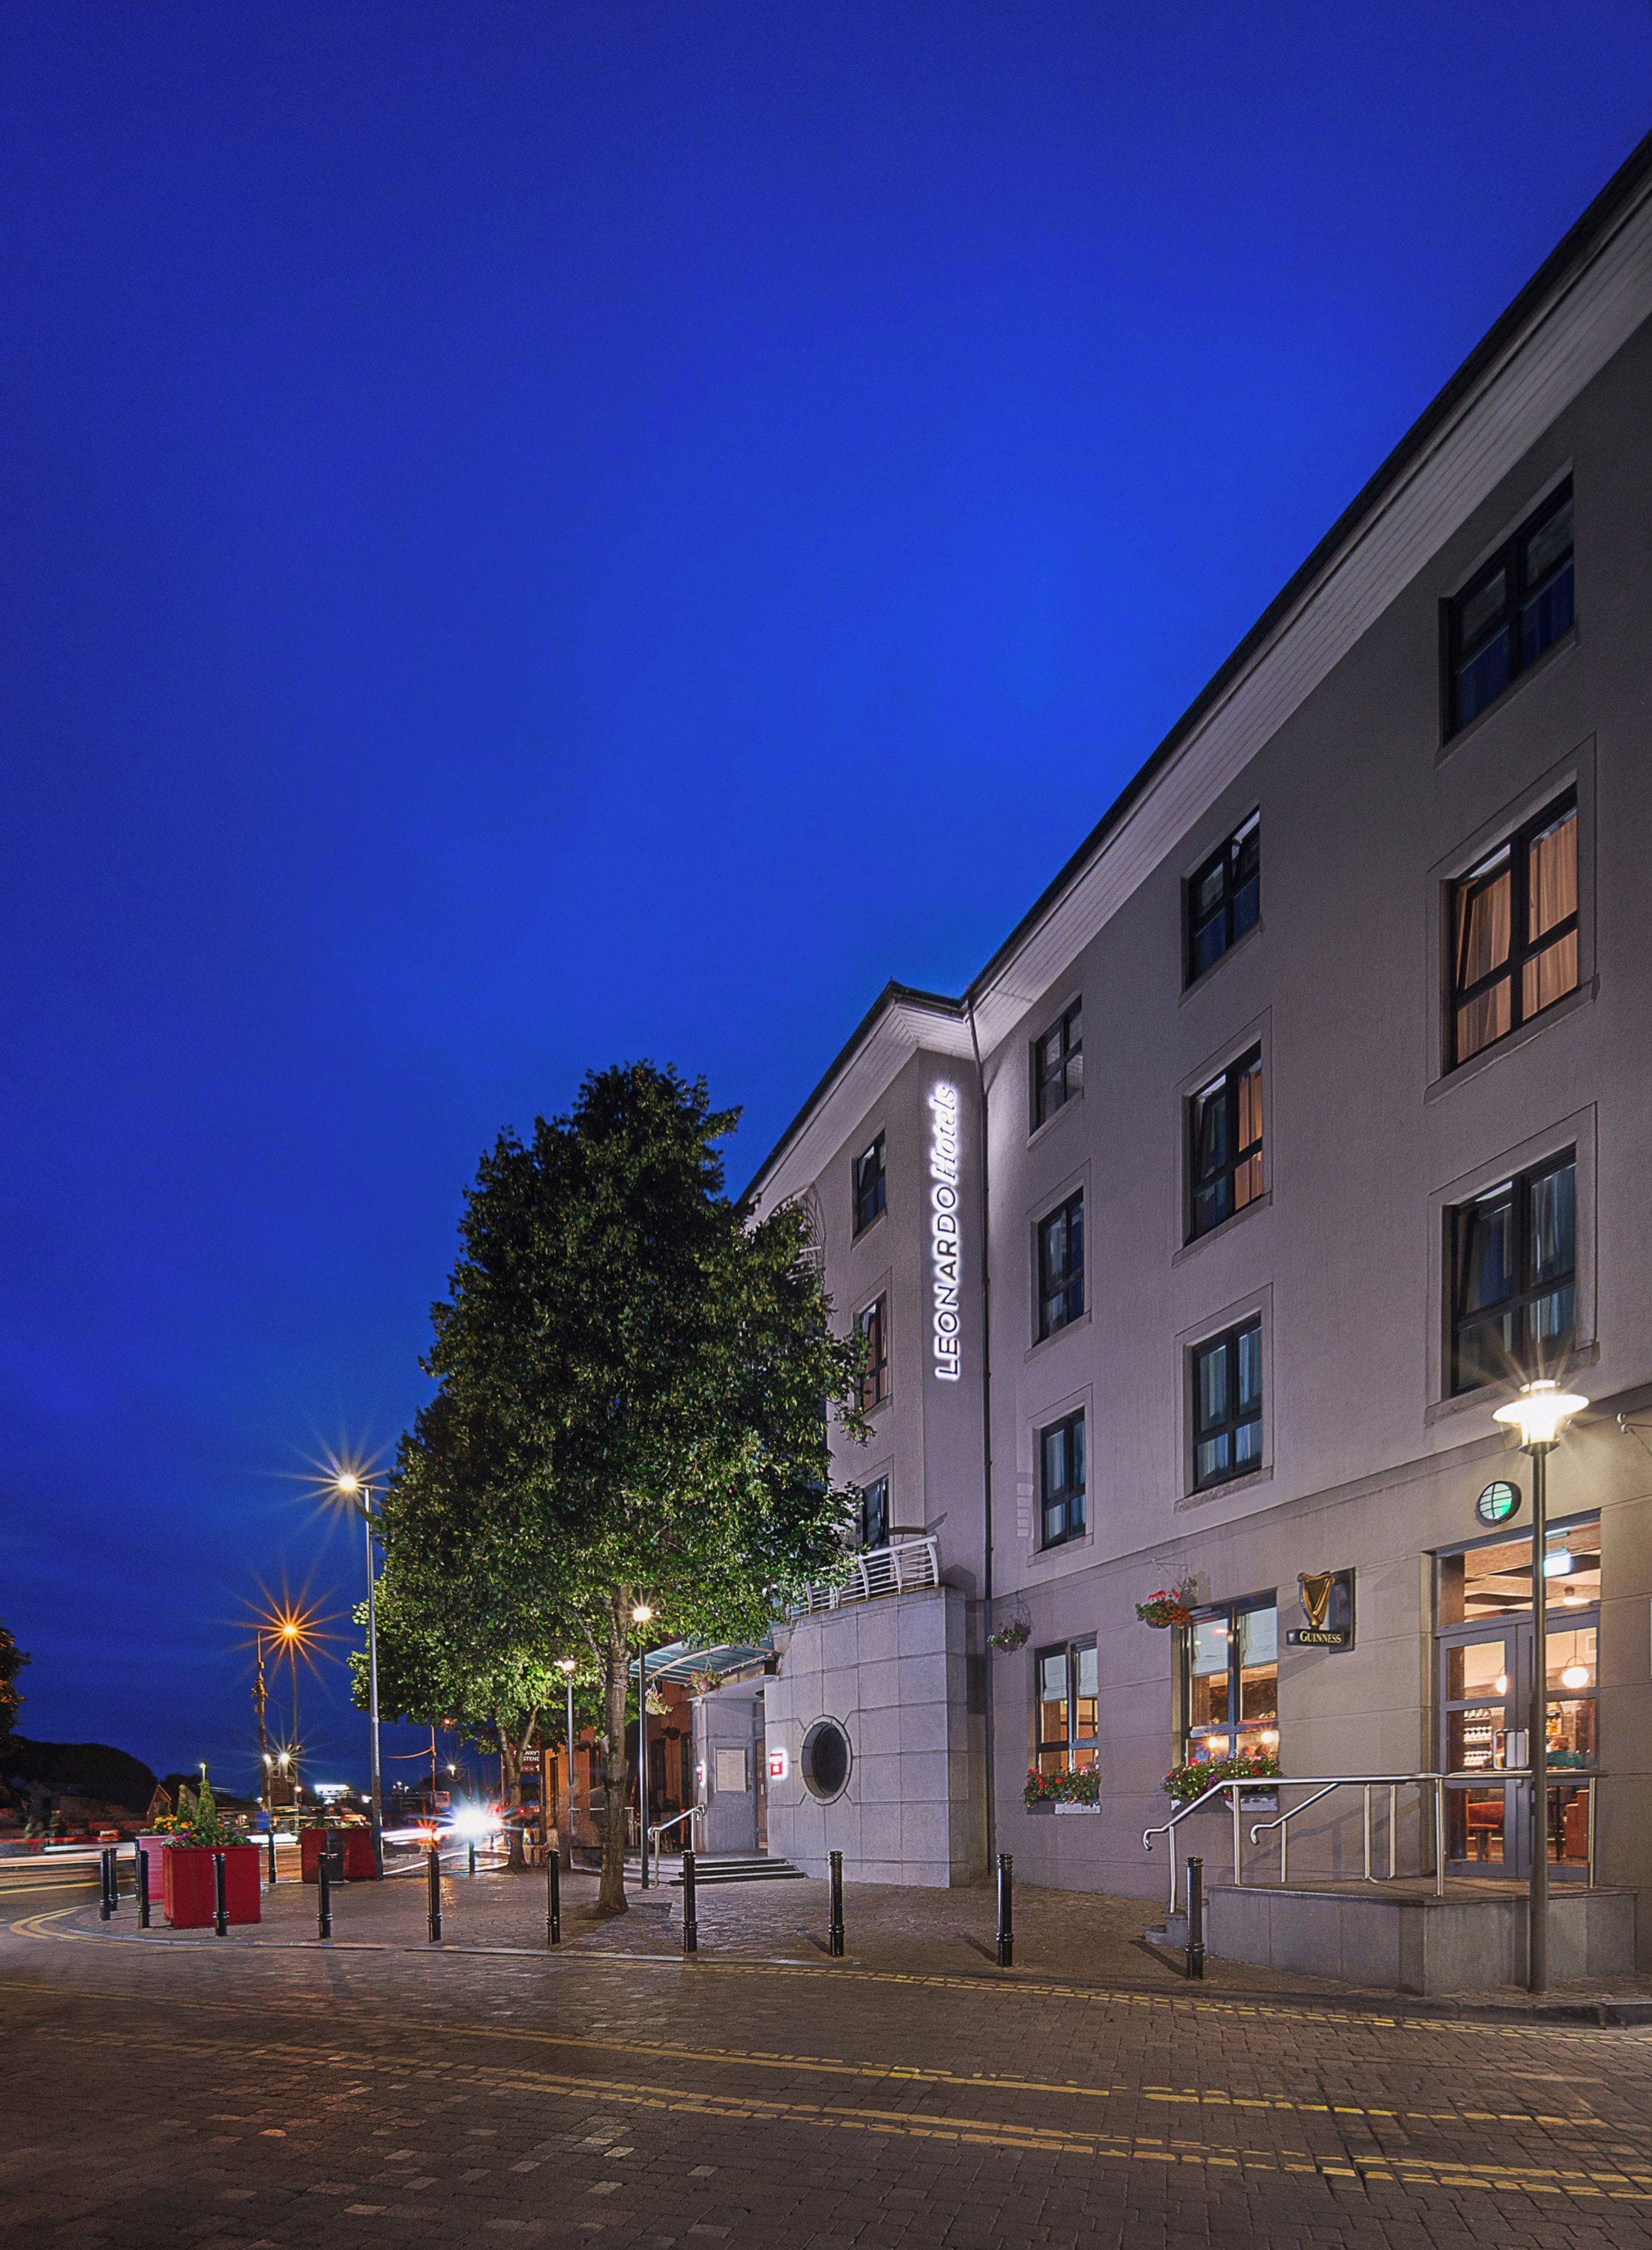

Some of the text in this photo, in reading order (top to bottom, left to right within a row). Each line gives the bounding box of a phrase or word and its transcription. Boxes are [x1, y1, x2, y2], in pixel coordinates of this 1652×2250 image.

[934, 1085, 958, 1376] LEONARDO Hotels
[1299, 1630, 1342, 1644] GUINNESS
